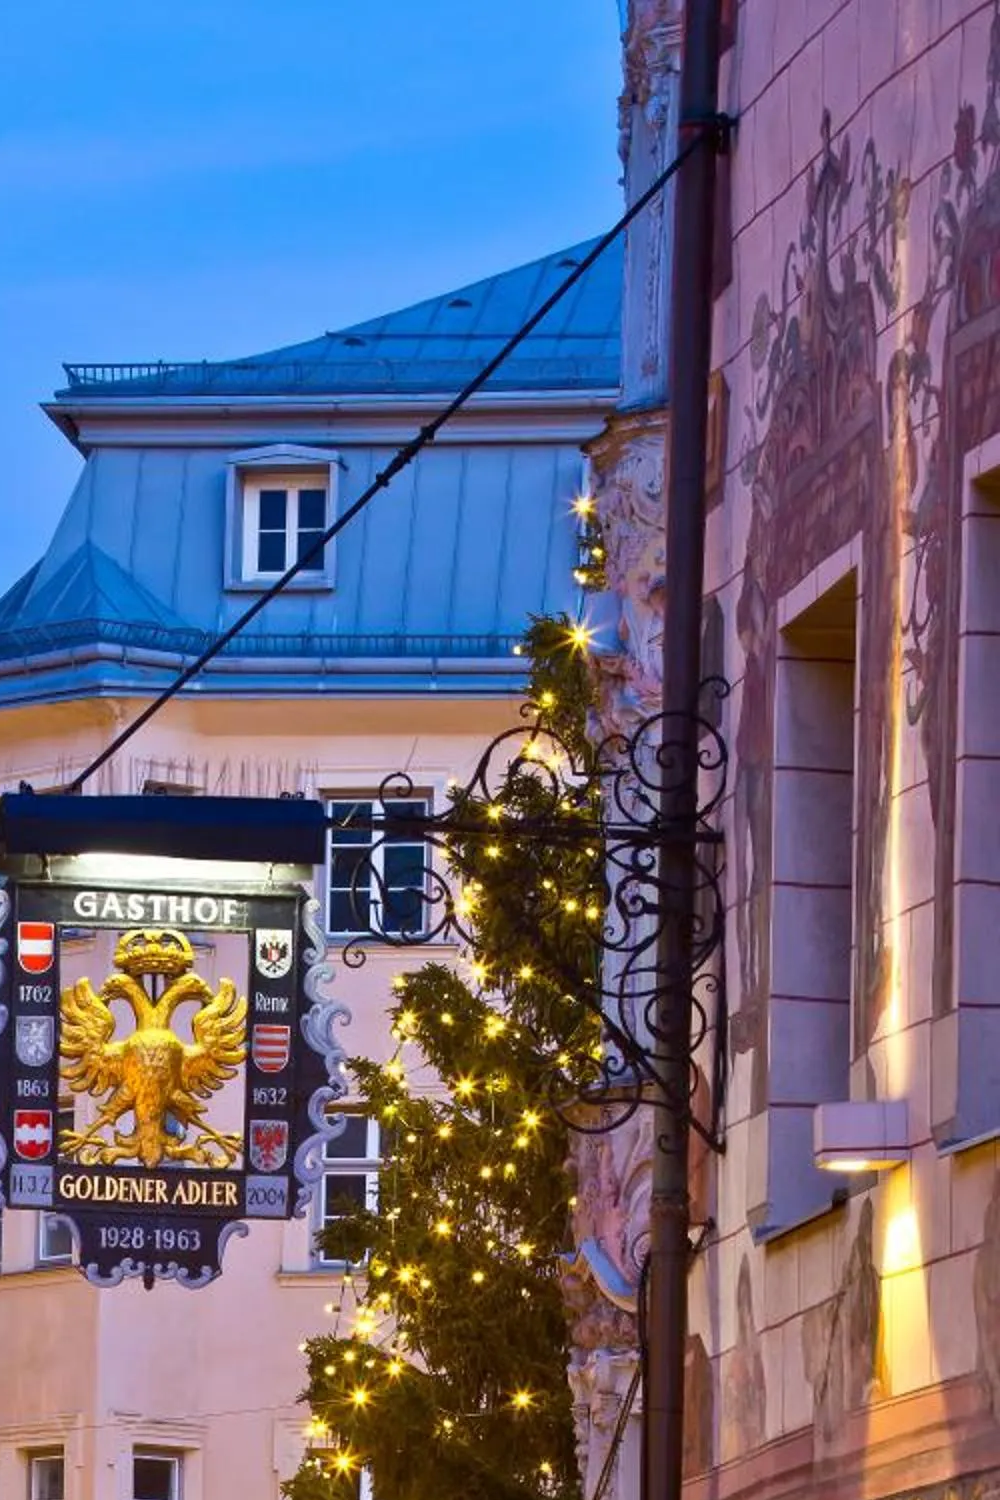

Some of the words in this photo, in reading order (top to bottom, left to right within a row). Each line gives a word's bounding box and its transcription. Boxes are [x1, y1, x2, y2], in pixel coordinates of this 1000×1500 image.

[73, 891, 240, 925] GASTHOF
[19, 984, 53, 1003] 1762
[16, 1079, 50, 1098] 1863
[59, 1173, 169, 1204] GOLDENER
[175, 1180, 239, 1207] ADLER
